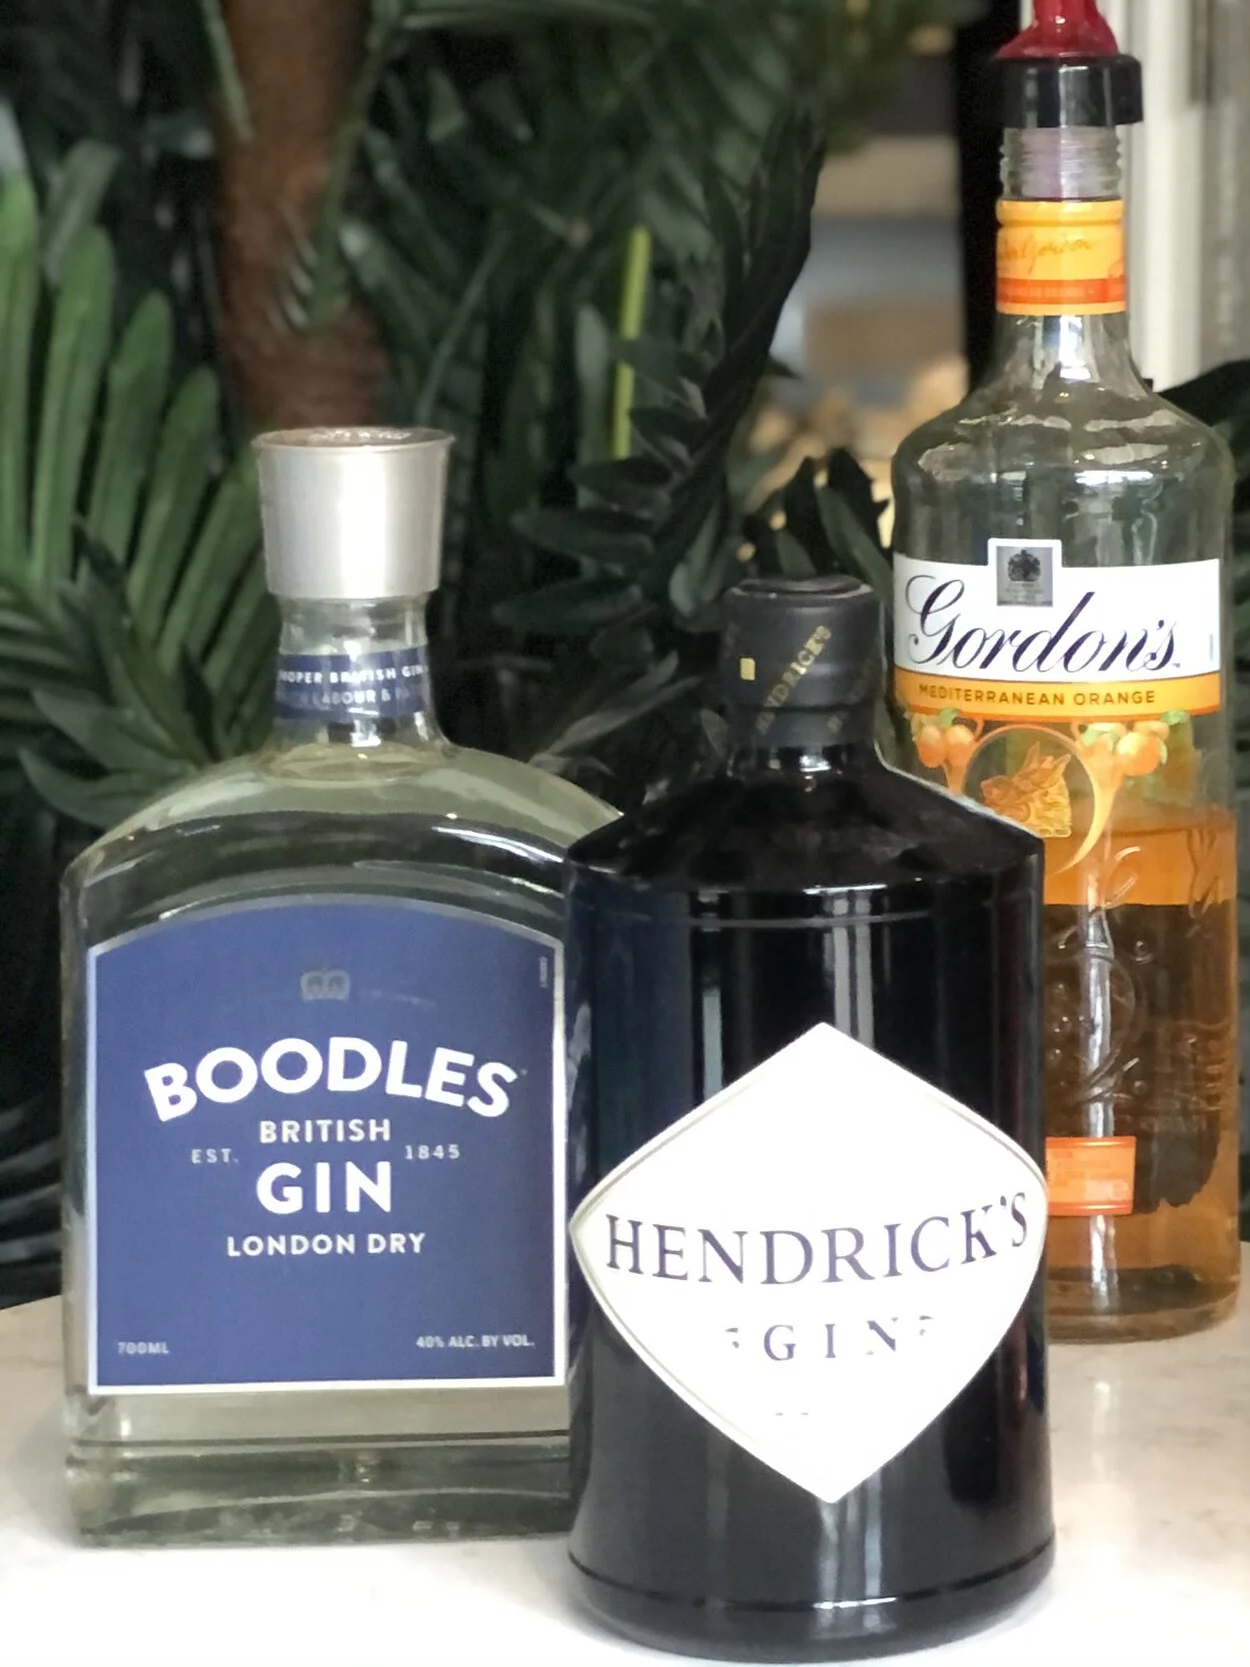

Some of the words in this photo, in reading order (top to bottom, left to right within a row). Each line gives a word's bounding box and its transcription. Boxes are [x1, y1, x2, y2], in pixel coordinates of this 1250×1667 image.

[904, 575, 1181, 674] Gordon's
[279, 669, 322, 684] OPER
[918, 684, 1066, 707] MEDITERRANEAN
[1073, 690, 1157, 706] ORANGE
[144, 1036, 518, 1123] BOODLES
[258, 1119, 391, 1144] BRITISH
[191, 1148, 239, 1164] EST.
[404, 1144, 461, 1161] 1845
[255, 1161, 392, 1214] GIN
[226, 1234, 356, 1257] LONDON
[367, 1232, 426, 1255] DRY
[605, 1191, 1028, 1285] HENDRICK'S
[117, 1340, 170, 1355] 700ML
[416, 1334, 445, 1349] 40%
[481, 1334, 500, 1348] BY
[762, 1317, 898, 1362] GIN
